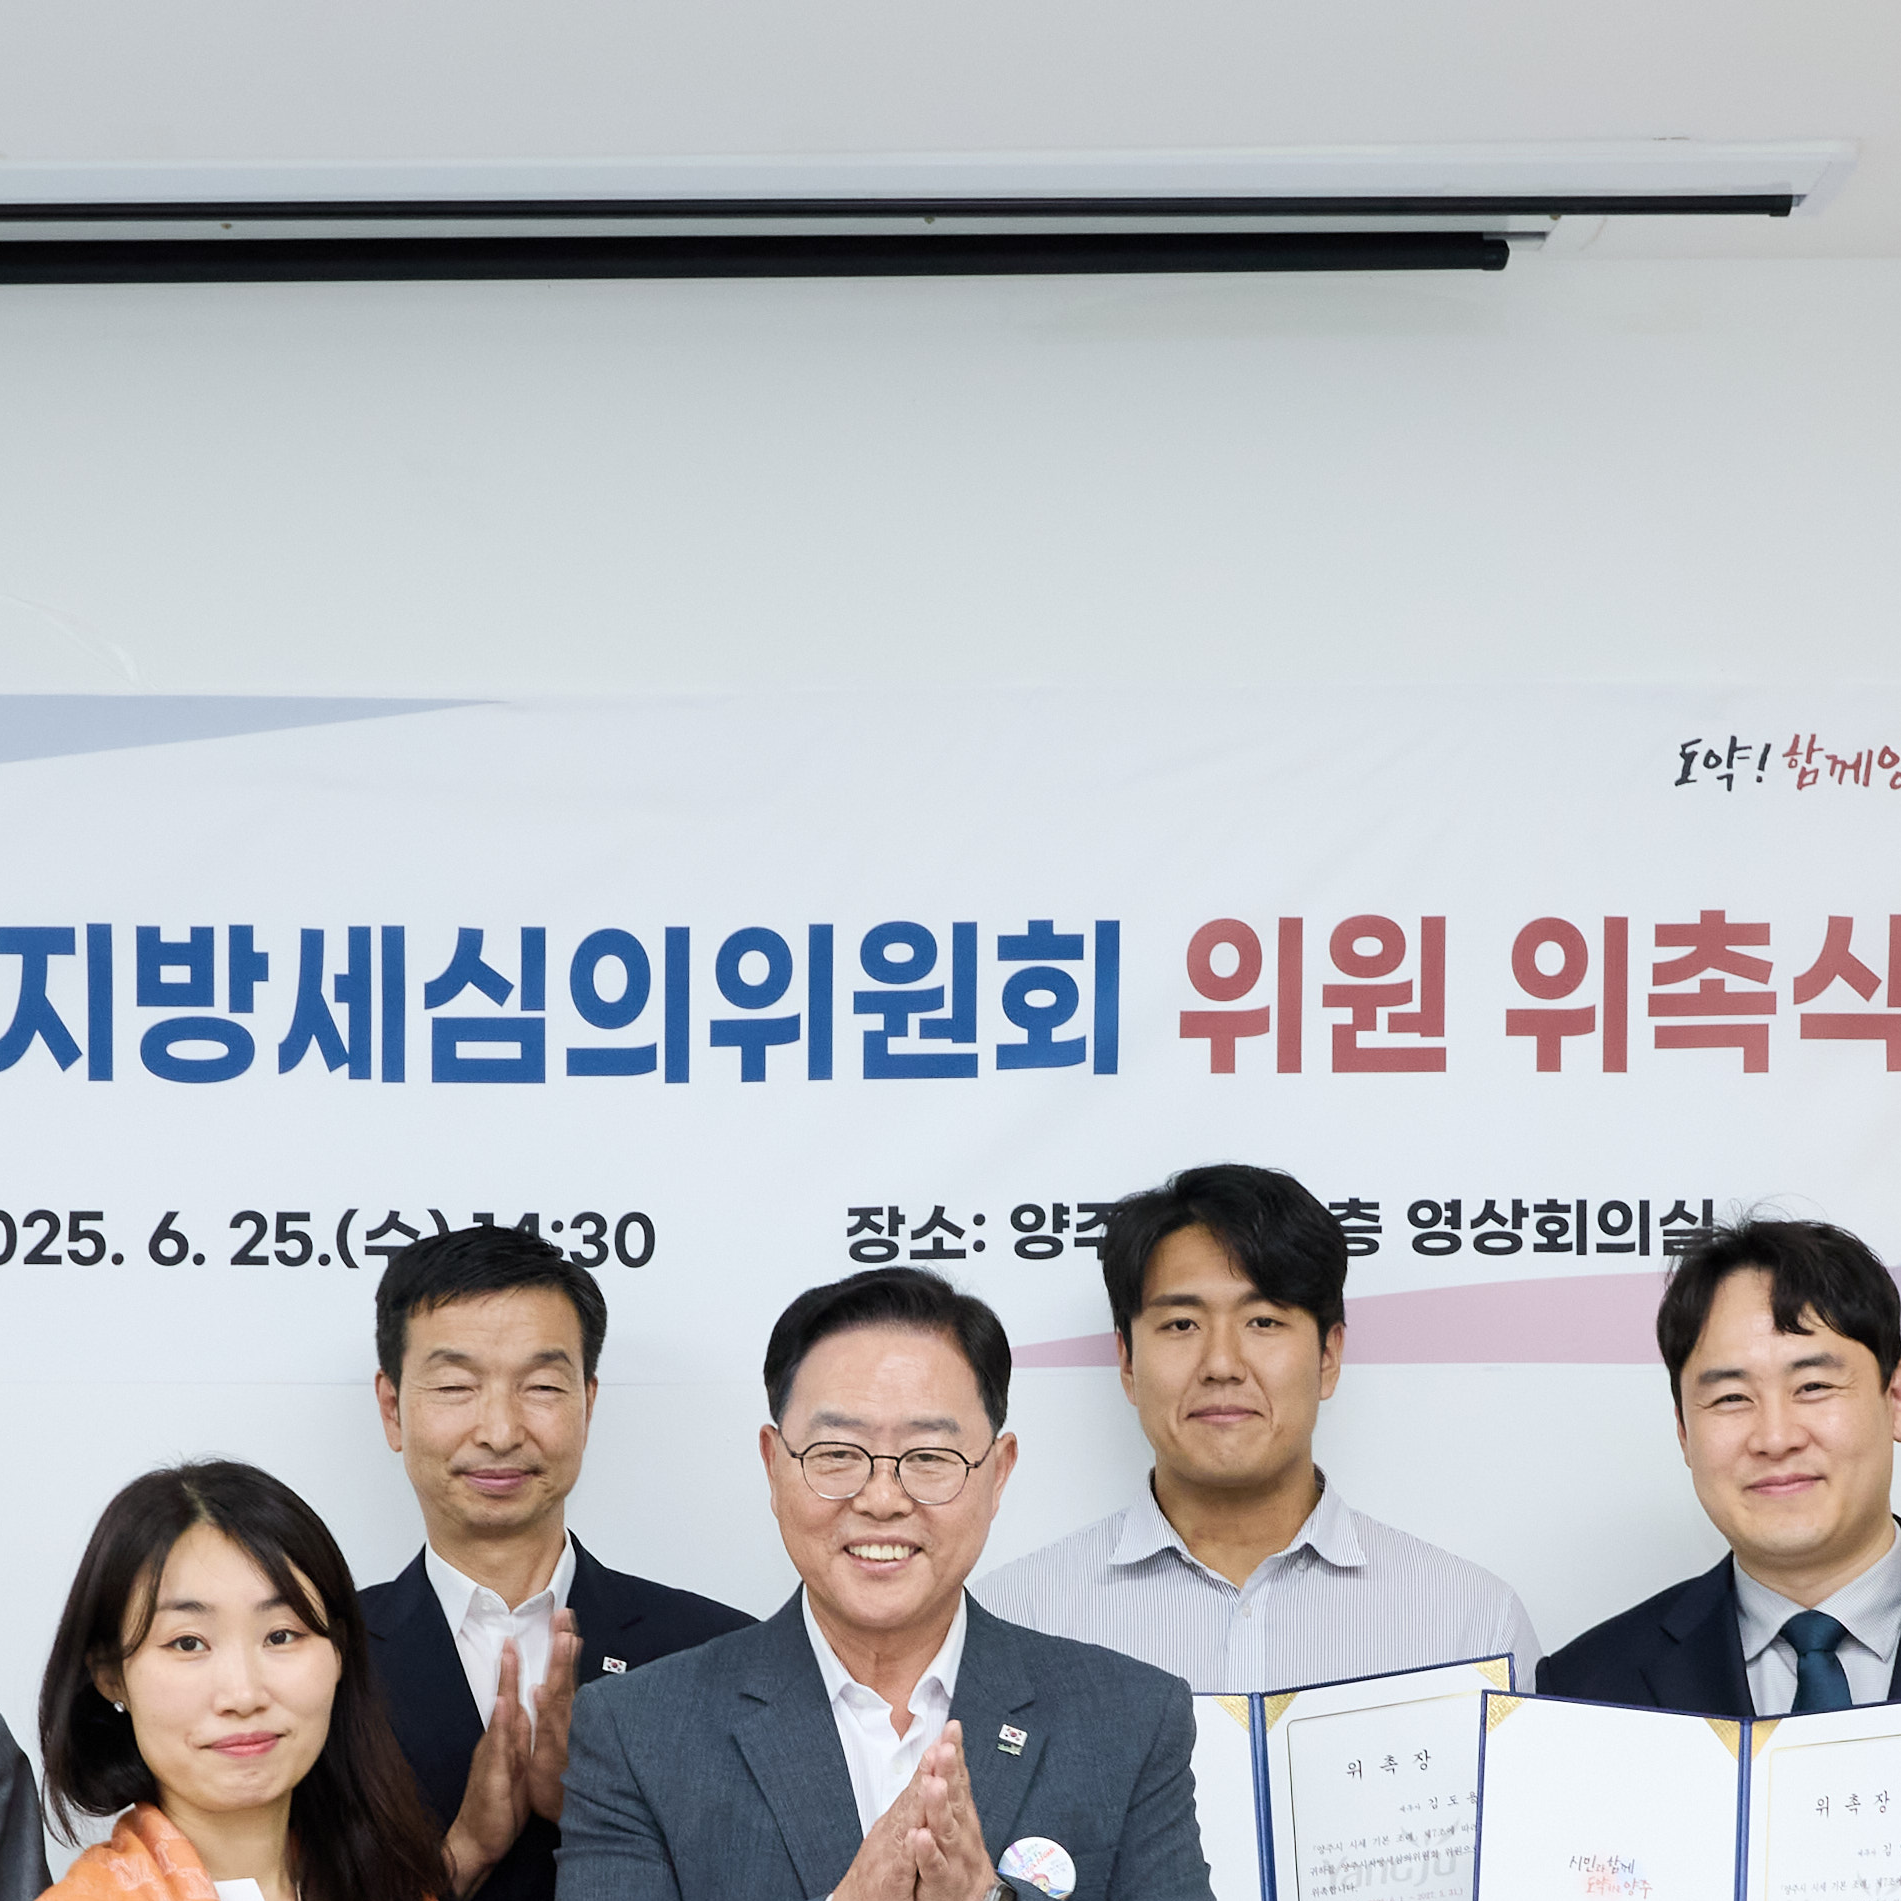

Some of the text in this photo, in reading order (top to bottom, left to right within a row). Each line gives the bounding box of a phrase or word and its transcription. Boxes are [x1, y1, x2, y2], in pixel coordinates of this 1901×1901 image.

[1674, 735, 1772, 792] 도약!
[1179, 914, 1448, 1075] 위원
[148, 1210, 206, 1268] 6.
[845, 1202, 987, 1264] 장소:
[1407, 1197, 1714, 1258] 영상회의실
